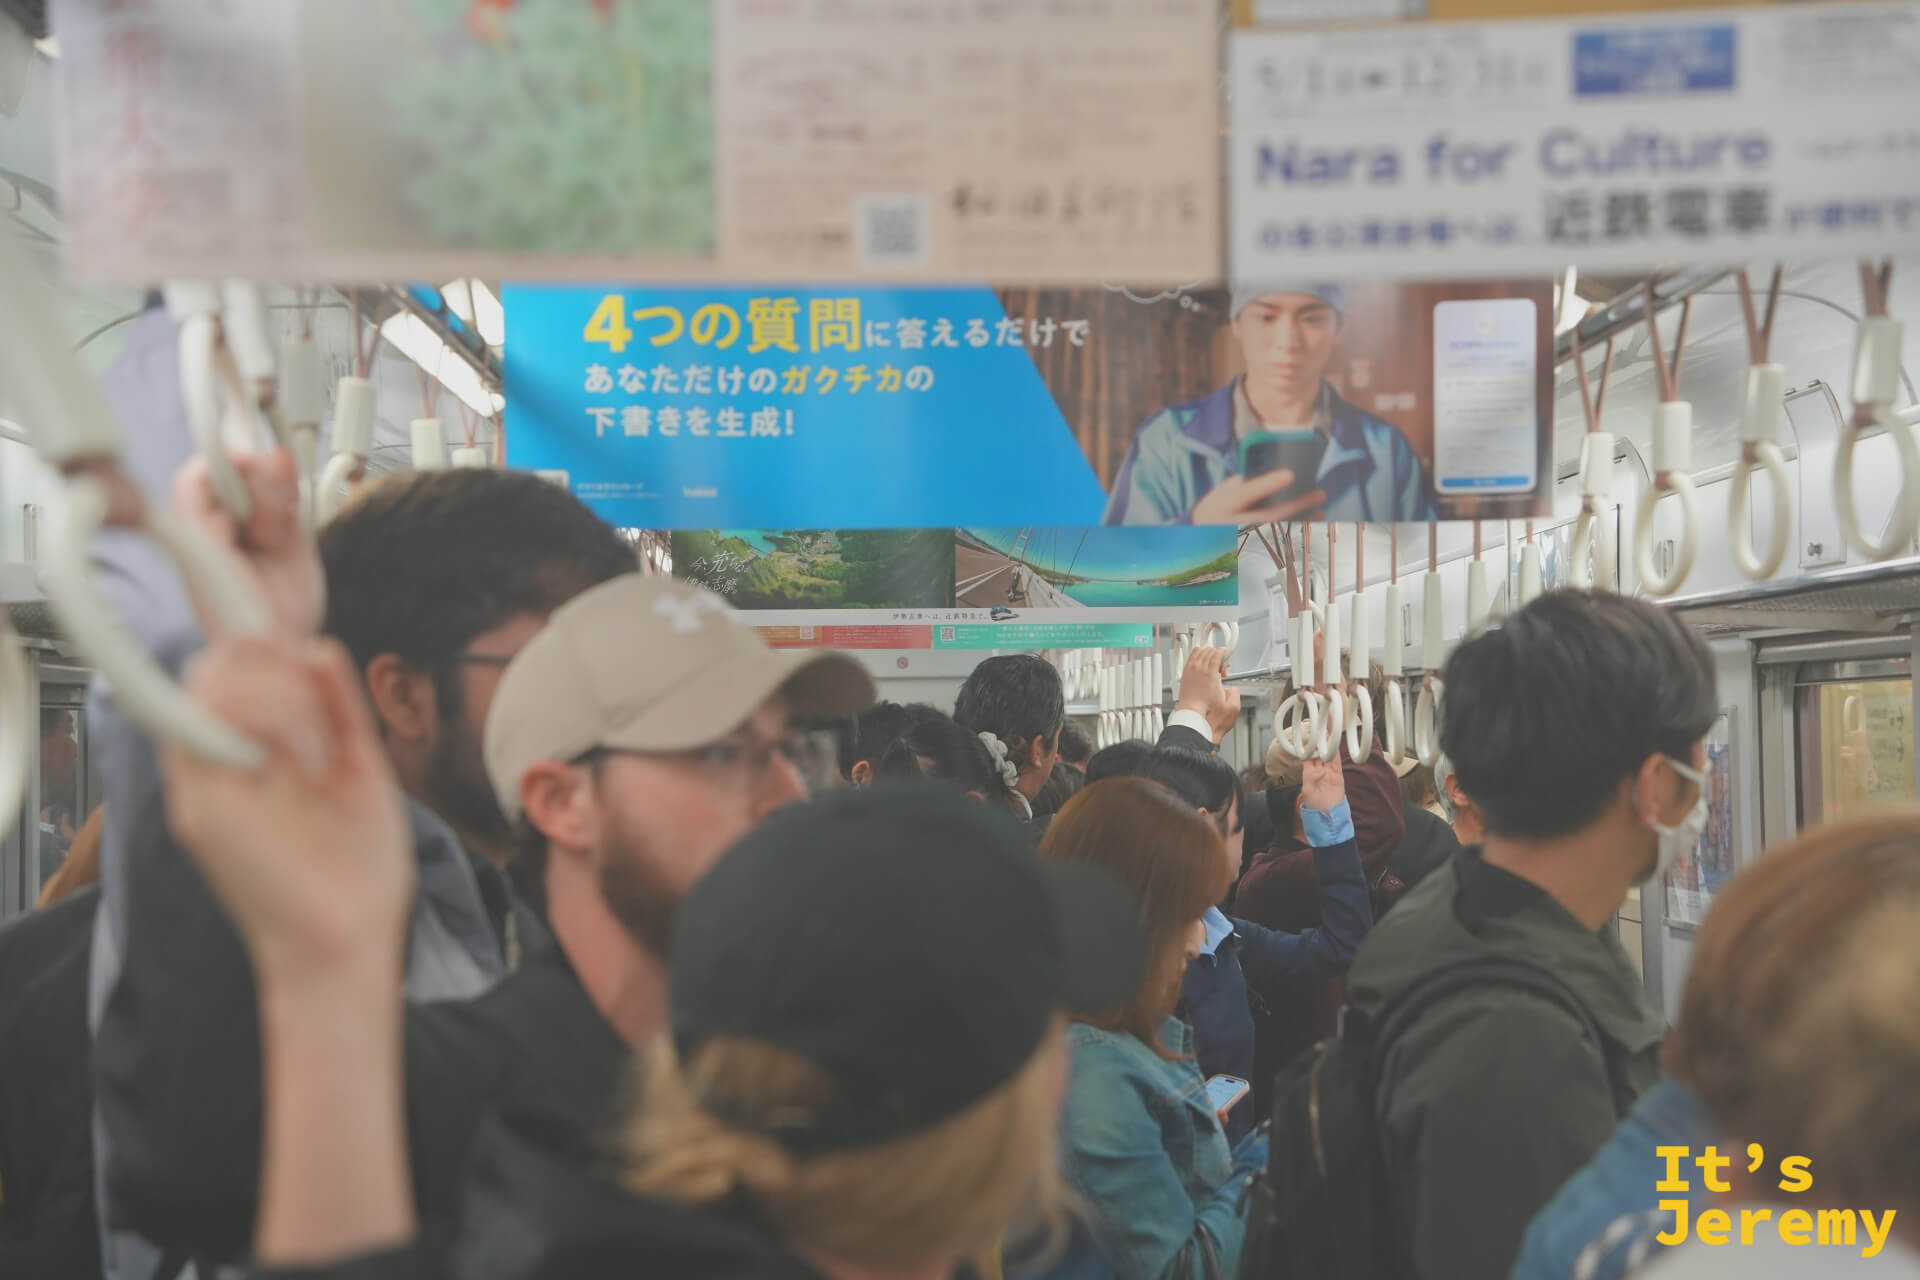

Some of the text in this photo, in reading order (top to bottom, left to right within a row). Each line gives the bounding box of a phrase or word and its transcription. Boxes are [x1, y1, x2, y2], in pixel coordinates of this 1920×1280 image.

[1257, 138, 1401, 187] Nara
[1426, 131, 1514, 181] for
[1539, 127, 1772, 179] Culture
[1544, 186, 1772, 243] 近鉄電車
[585, 294, 1089, 353] 4つの質問に答えるだけで
[585, 363, 934, 395] あなただけのガクチカの
